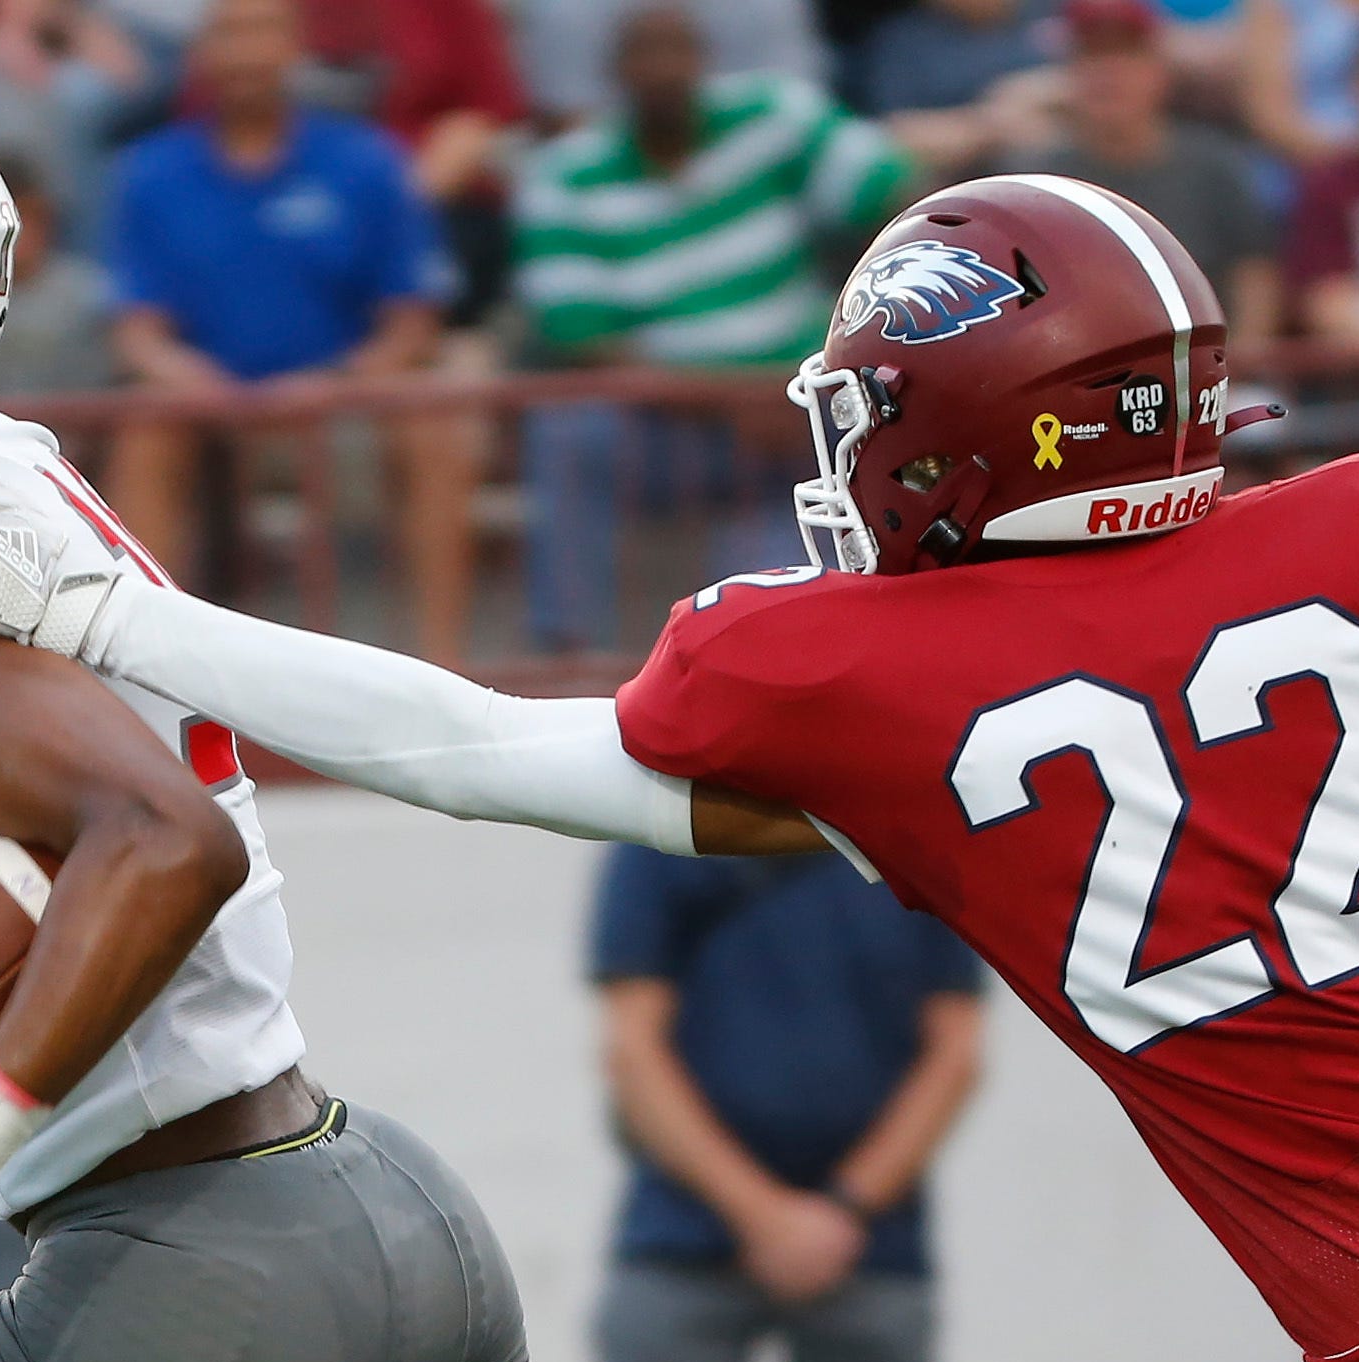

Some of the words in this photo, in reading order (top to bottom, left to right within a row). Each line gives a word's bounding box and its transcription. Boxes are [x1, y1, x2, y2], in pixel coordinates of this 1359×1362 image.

[1121, 383, 1164, 412] KRD
[1063, 423, 1109, 436] Riddell
[1132, 409, 1157, 434] 63
